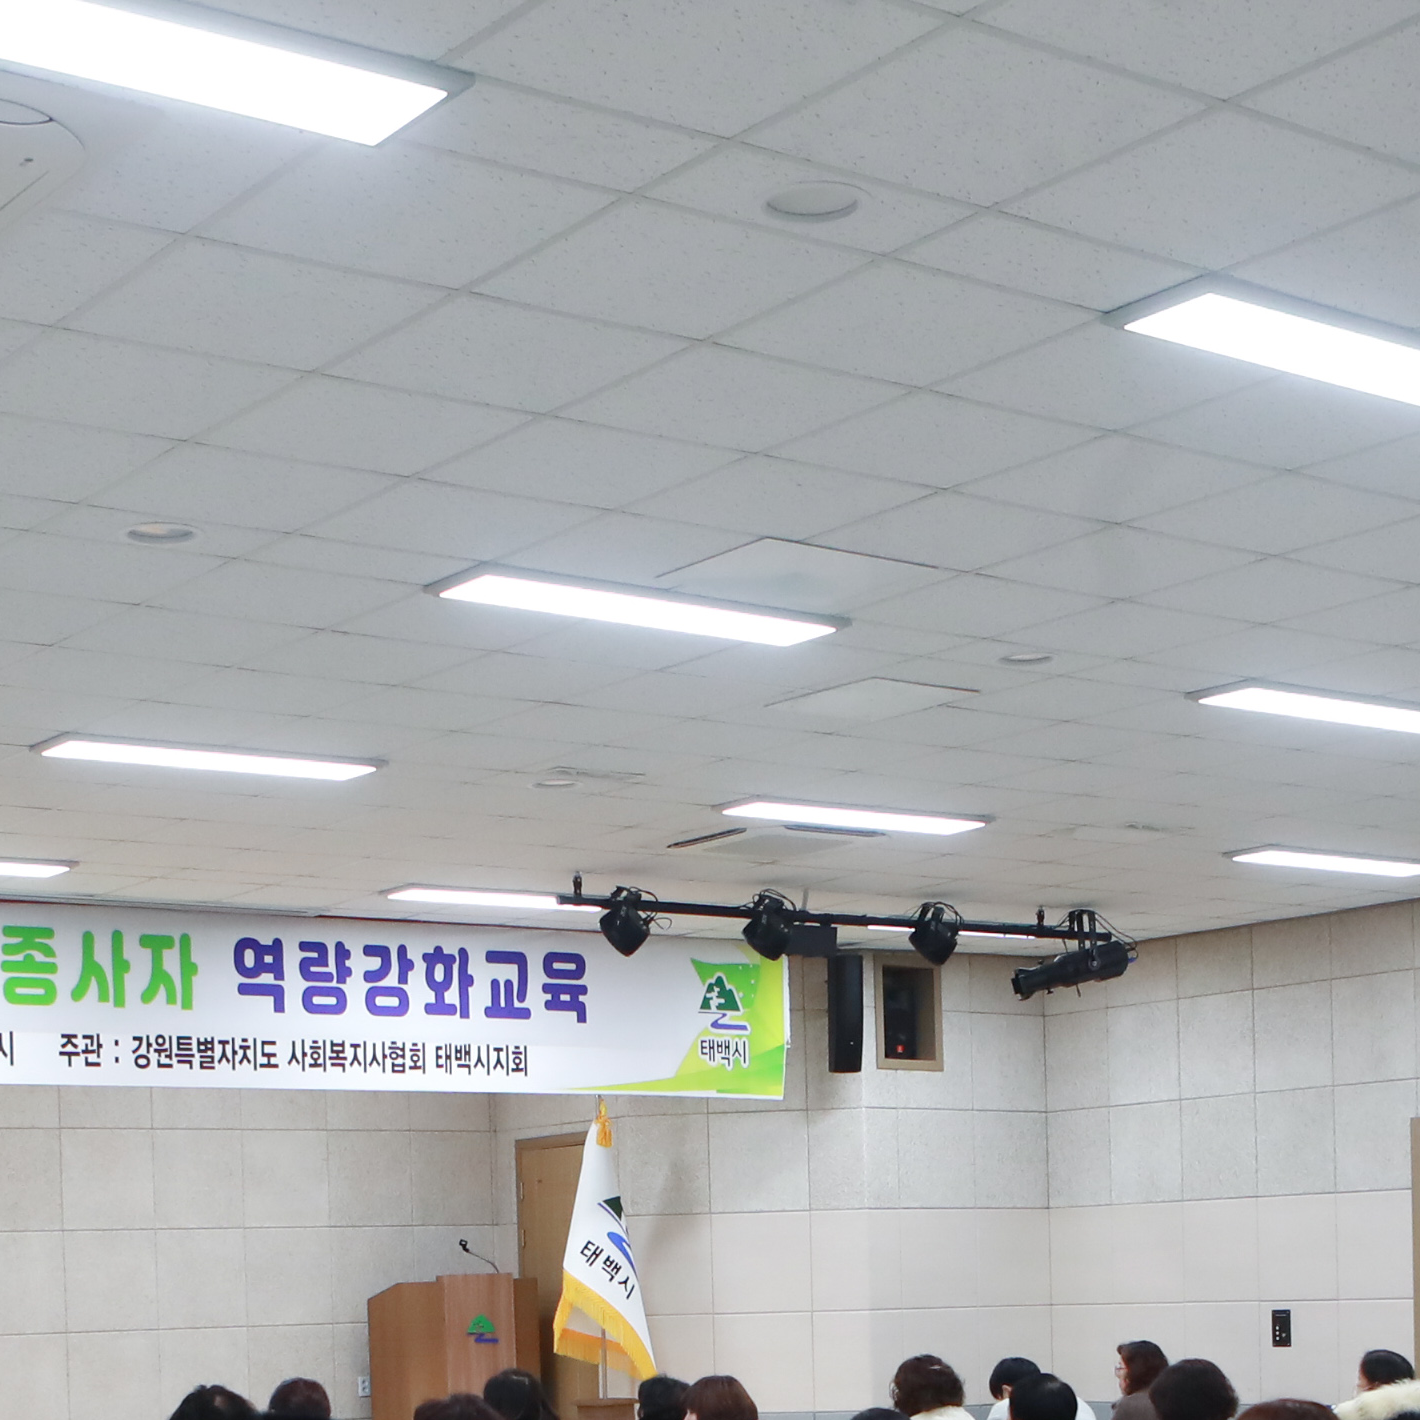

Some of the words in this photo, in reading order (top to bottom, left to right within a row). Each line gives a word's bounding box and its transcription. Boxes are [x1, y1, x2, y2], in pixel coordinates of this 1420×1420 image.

[1, 925, 198, 1011] 종사자
[234, 937, 587, 1023] 역량강화교육
[132, 1034, 279, 1071] 강원특별자치도
[288, 1039, 426, 1073] 사회복지사협회
[435, 1044, 528, 1076] 태백시지회
[700, 1039, 746, 1064] 태백시
[580, 1240, 635, 1300] 태백시
